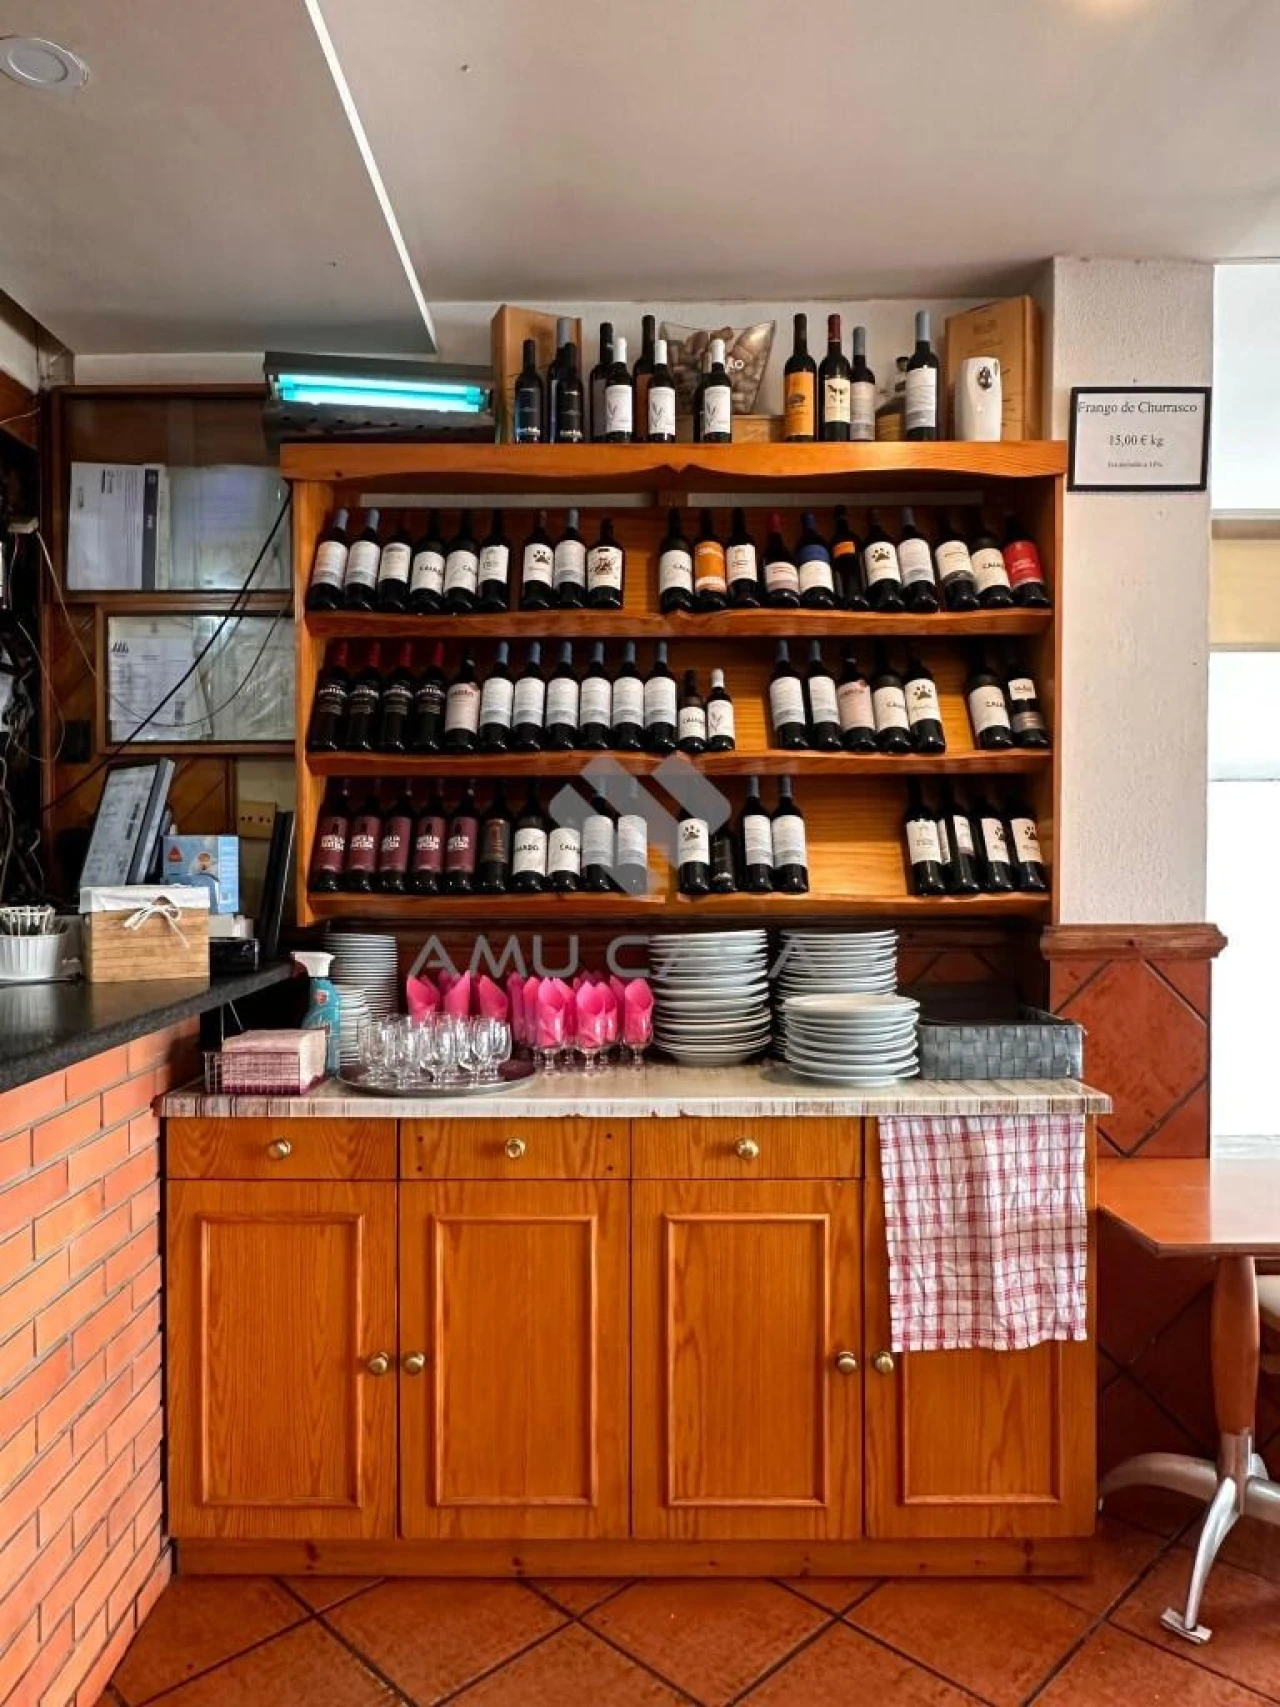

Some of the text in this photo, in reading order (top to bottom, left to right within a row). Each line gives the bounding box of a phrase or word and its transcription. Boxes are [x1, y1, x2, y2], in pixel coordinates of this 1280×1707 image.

[1077, 401, 1198, 415] Frango de Churrasco
[1109, 432, 1165, 448] 15,00 € kg
